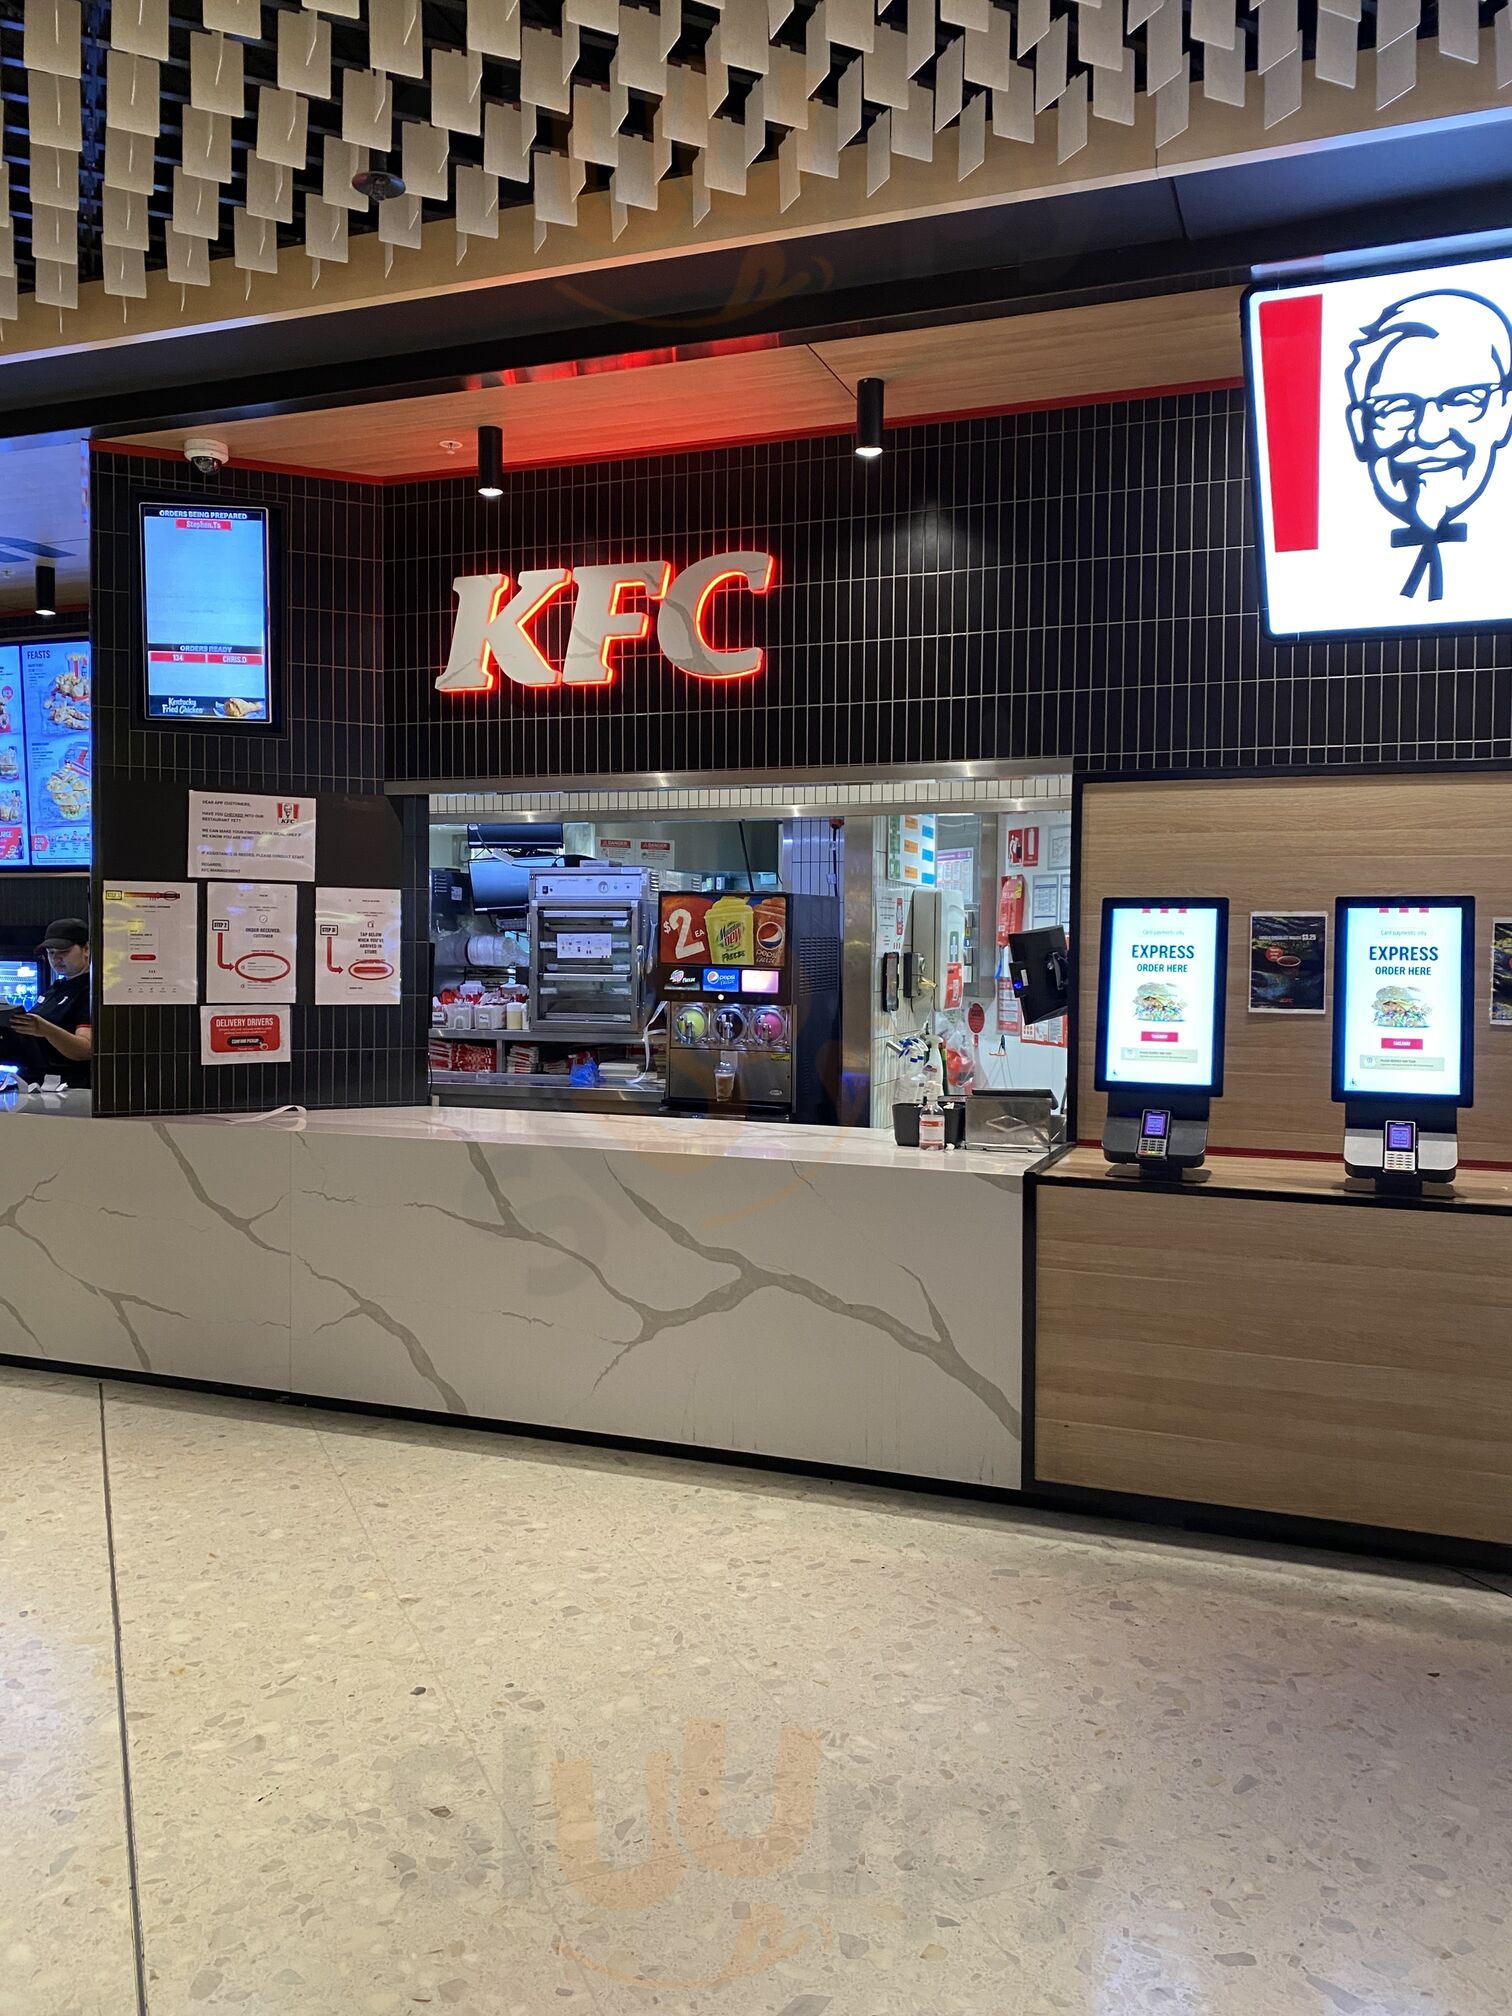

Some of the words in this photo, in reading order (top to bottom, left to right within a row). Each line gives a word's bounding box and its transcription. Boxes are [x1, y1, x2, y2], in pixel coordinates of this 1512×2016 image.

[434, 551, 774, 692] KFC
[27, 650, 50, 659] FEASTS
[168, 698, 196, 707] Kentucky
[162, 704, 178, 713] Fried
[179, 705, 203, 714] Chicken
[669, 908, 705, 960] 2
[694, 929, 705, 938] EA
[1132, 944, 1195, 959] EXPRESS
[1369, 946, 1439, 961] EXPRESS
[1137, 964, 1164, 972] ORDER
[1167, 964, 1188, 972] HERE
[1375, 966, 1405, 975] ORDER
[1408, 967, 1431, 975] HERE
[216, 1018, 246, 1027] DELIVERY
[247, 1017, 273, 1026] DRIVERS
